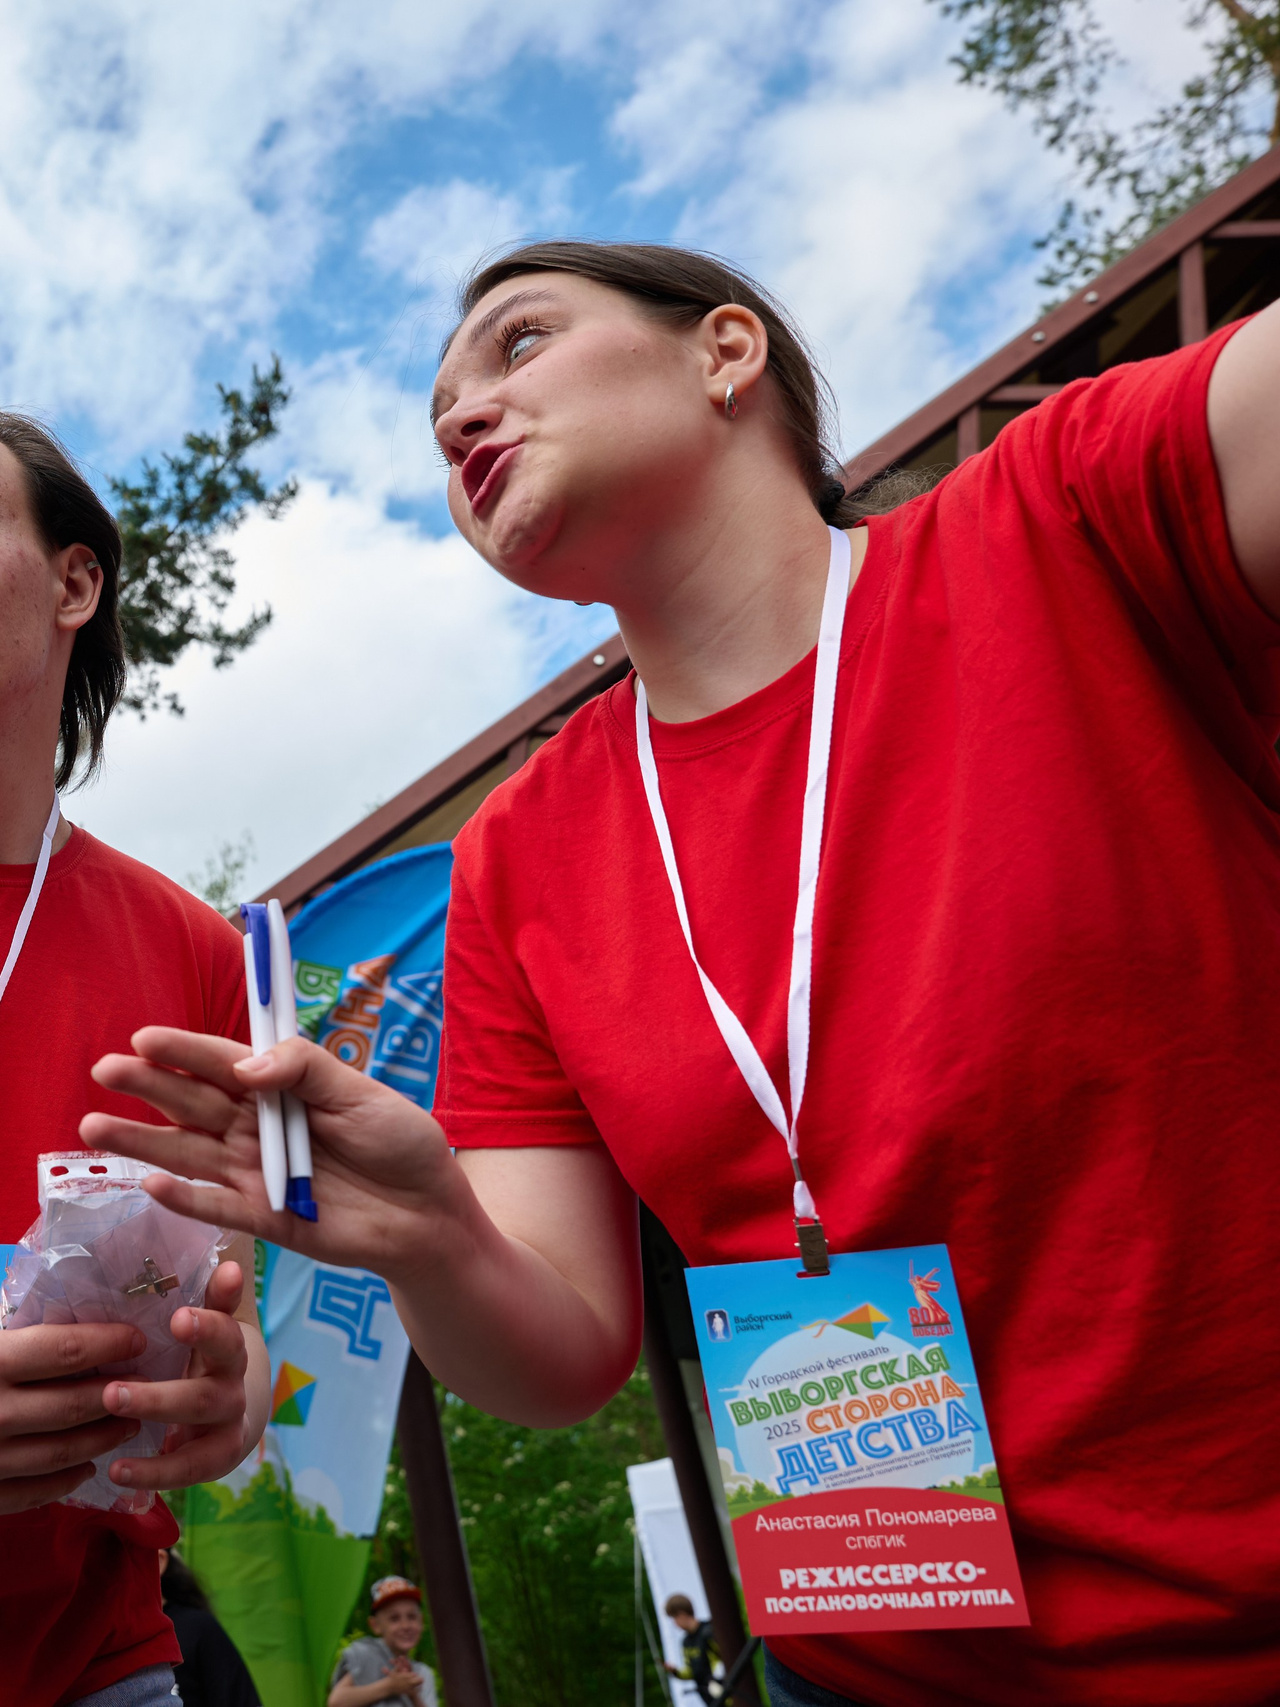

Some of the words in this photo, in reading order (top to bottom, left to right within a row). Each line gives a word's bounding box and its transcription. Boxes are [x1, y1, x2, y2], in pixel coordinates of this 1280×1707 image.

[734, 1311, 793, 1325] Выборгский
[735, 1322, 764, 1334] район
[908, 1307, 931, 1325] 80
[748, 1378, 760, 1390] IV
[762, 1360, 825, 1386] Городской
[826, 1345, 890, 1373] фестиваль
[729, 1345, 951, 1427] ВЫБОРГСКАЯ
[763, 1419, 802, 1441] 2025
[805, 1375, 966, 1434] СТОРОНА
[775, 1400, 982, 1494] ДЕТСТВА
[755, 1512, 860, 1532] Анастасия
[865, 1507, 997, 1527] Пономарева
[845, 1534, 907, 1550] СПбГИК
[779, 1560, 987, 1590] РЕЖИССЕРСКО-
[764, 1590, 936, 1614] ПОСТАНОВОЧНАЯ
[938, 1588, 1015, 1608] ГРУППА
